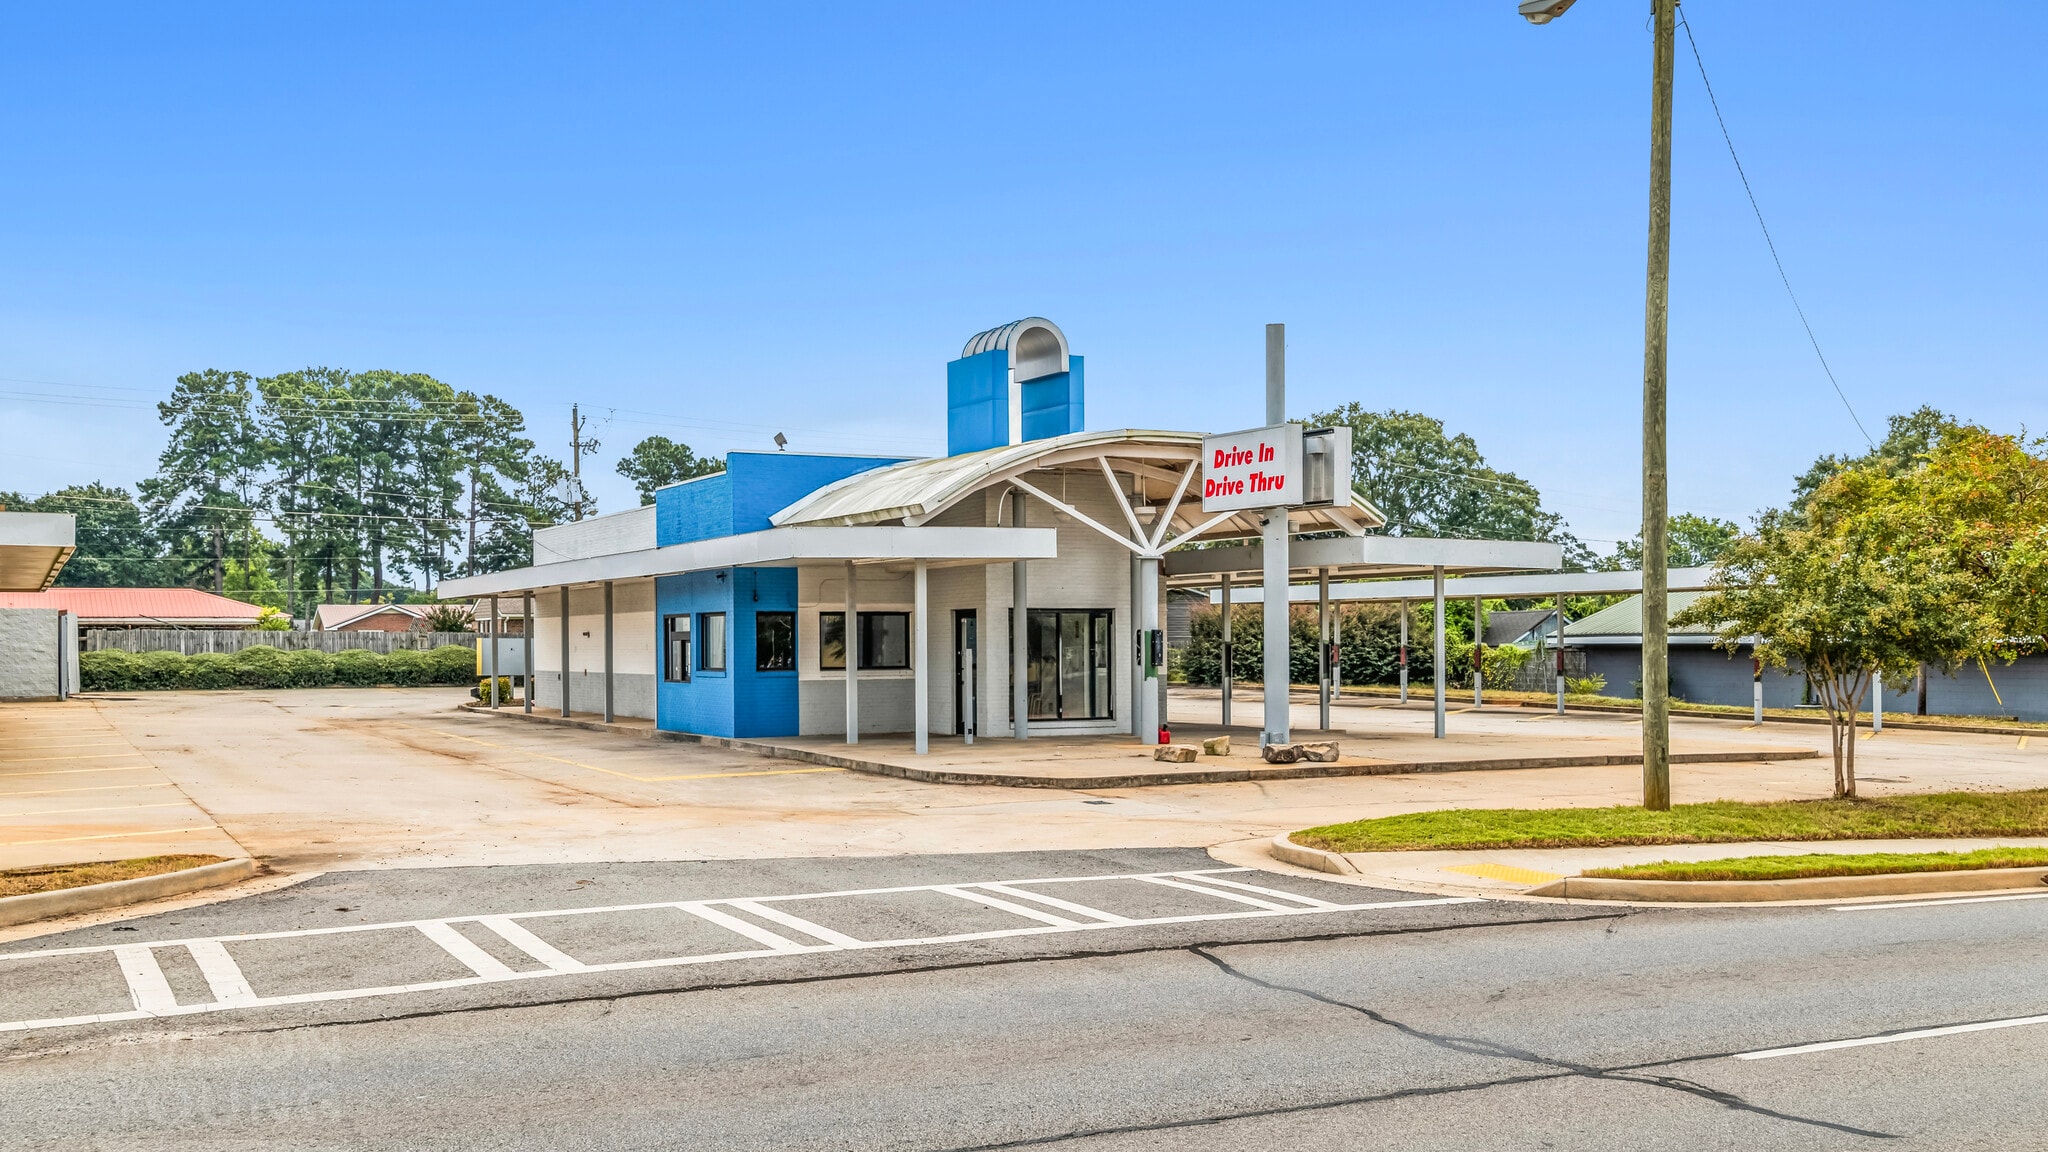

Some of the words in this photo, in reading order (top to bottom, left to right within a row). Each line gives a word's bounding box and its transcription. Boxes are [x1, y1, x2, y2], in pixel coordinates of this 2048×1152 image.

[1214, 446, 1253, 469] Drive
[1258, 442, 1275, 463] In
[1205, 475, 1244, 498] Drive
[1249, 471, 1285, 493] Thru
